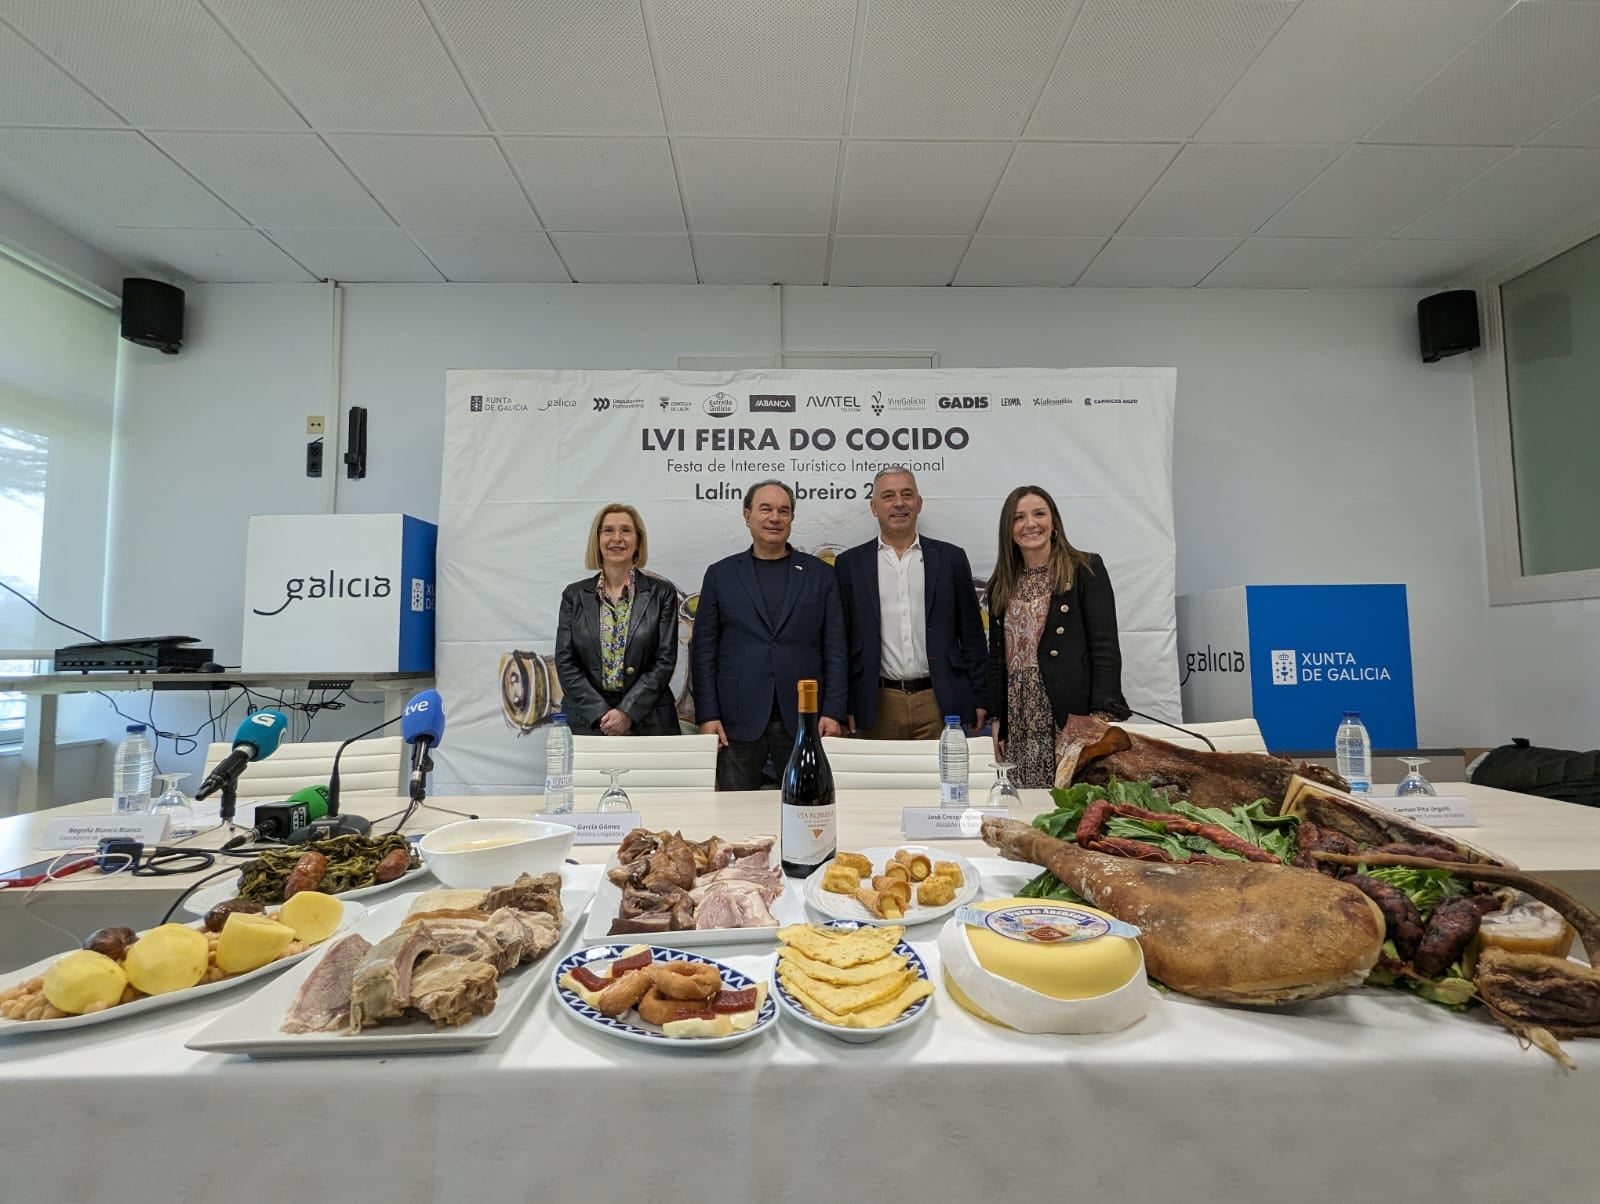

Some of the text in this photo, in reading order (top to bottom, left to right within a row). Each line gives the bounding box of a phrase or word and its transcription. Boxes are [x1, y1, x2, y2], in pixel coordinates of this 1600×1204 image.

[538, 398, 577, 411] galicia
[806, 395, 861, 407] AVATEL
[938, 396, 989, 409] GADIS
[642, 427, 969, 451] LVI FEIRA DO COCIDO
[667, 458, 703, 472] Festa
[708, 458, 726, 472] de
[731, 458, 785, 472] Interese
[790, 457, 846, 472] Turístico
[253, 570, 391, 616] galicia
[1181, 644, 1245, 686] galicia
[1302, 652, 1356, 665] XUNTA
[1302, 667, 1391, 681] DE GALICIA
[405, 700, 429, 716] tve
